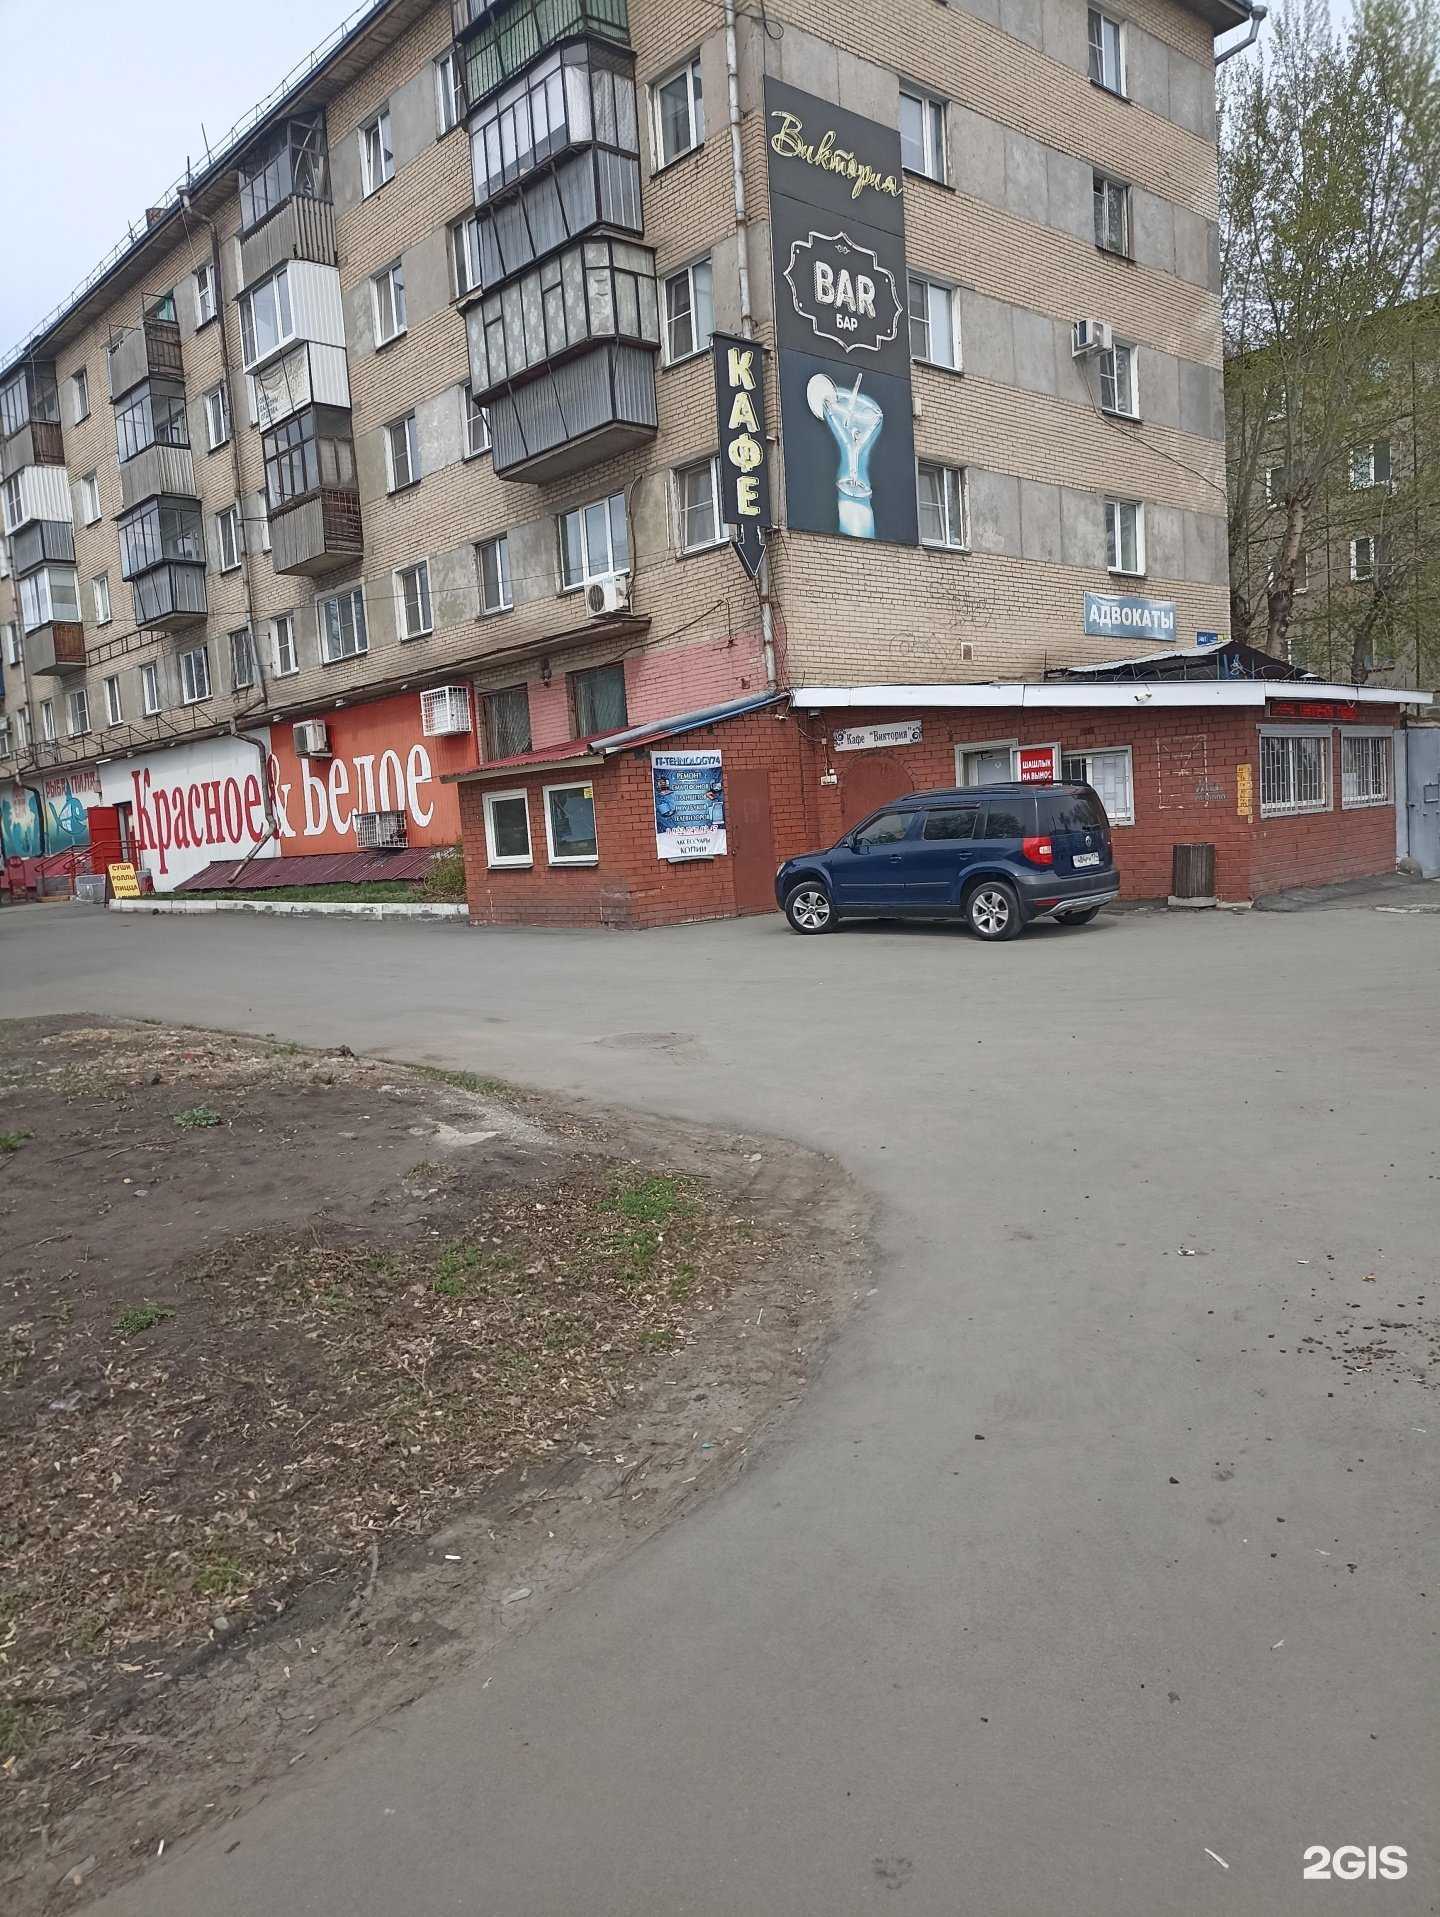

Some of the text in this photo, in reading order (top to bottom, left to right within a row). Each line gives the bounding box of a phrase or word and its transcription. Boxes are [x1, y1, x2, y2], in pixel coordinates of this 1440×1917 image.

[771, 111, 903, 200] Виктория
[814, 261, 876, 319] BAR
[836, 314, 858, 332] БАР
[727, 347, 764, 516] КАФЕ
[1088, 604, 1174, 630] АДВОКАТЫ
[847, 727, 912, 747] Кафе "Виктория"
[1022, 759, 1052, 769] ШАШЛЫК
[676, 772, 702, 781] РЕМОНТ
[1022, 771, 1031, 781] НА
[131, 768, 264, 874] Красное
[114, 884, 138, 892] ПИЦЦА
